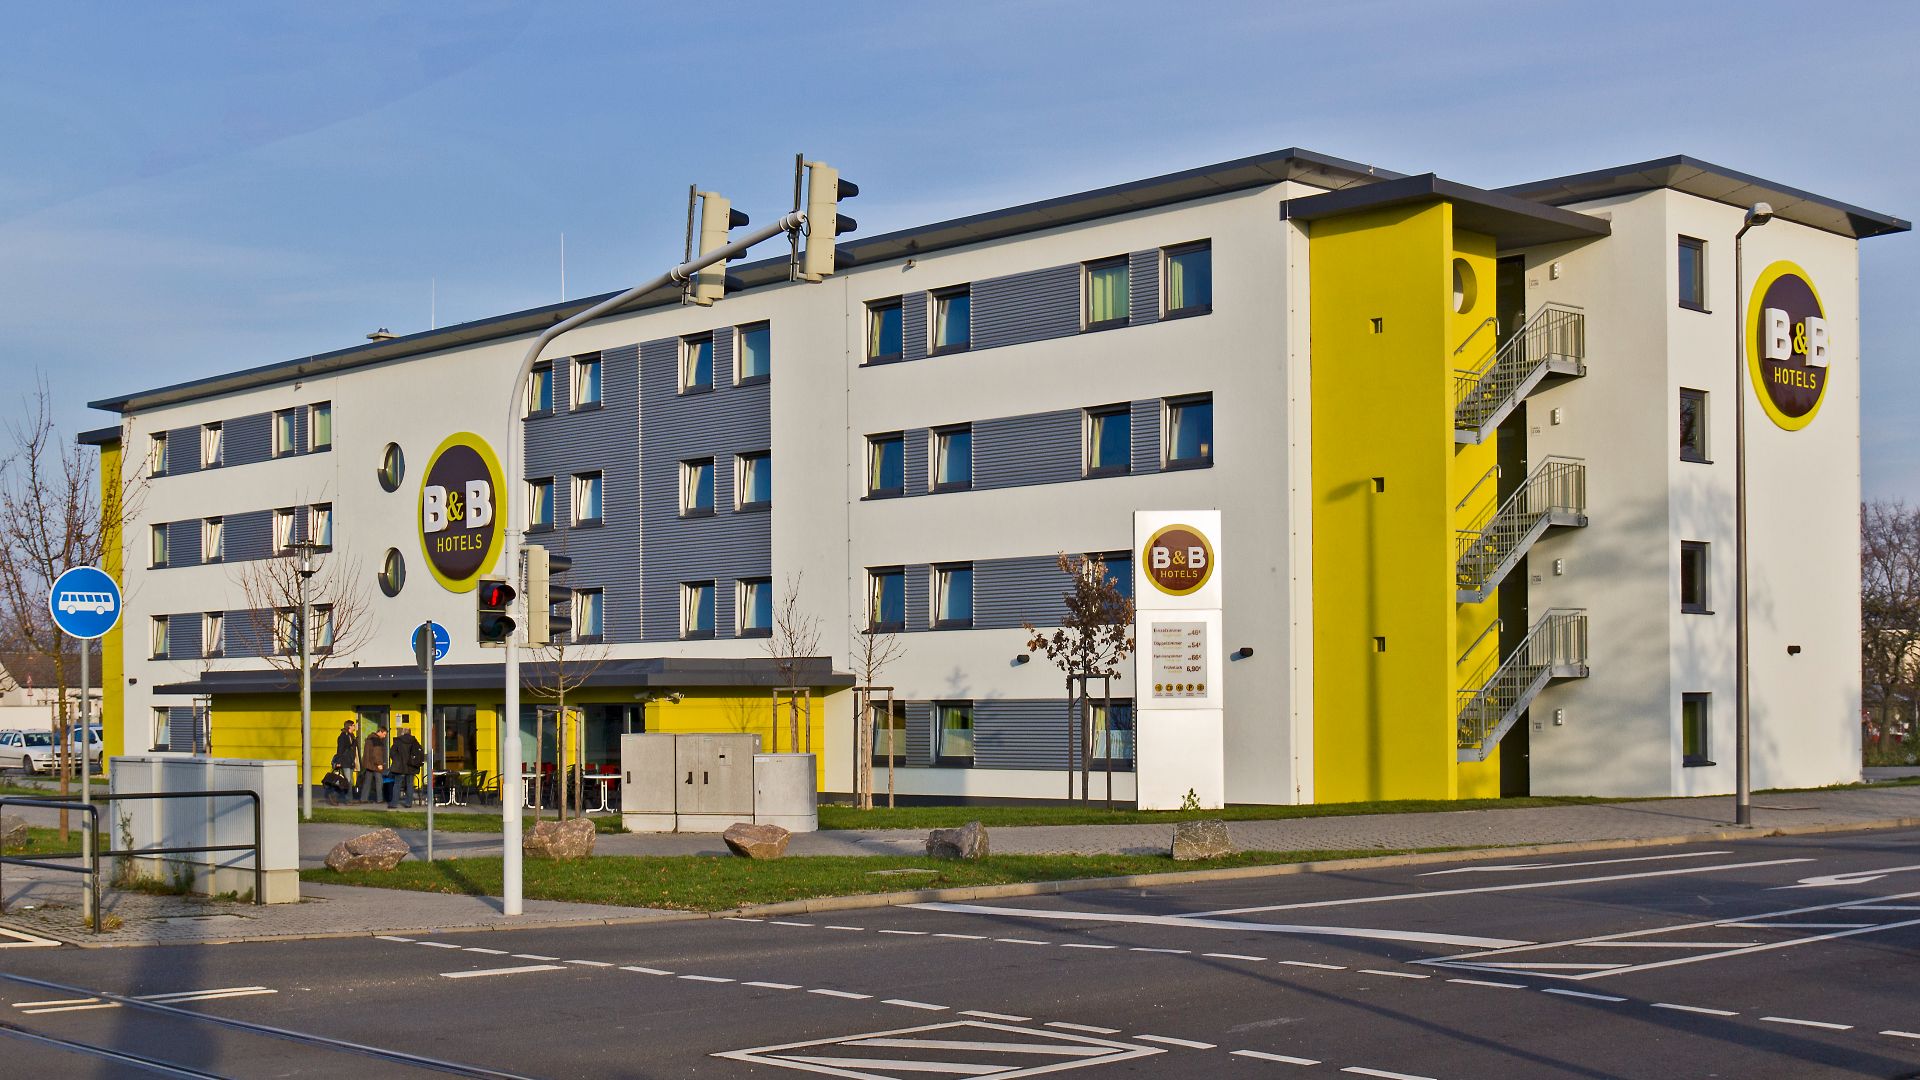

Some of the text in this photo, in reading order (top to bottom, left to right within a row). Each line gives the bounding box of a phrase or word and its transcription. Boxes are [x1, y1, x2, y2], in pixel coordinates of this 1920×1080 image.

[1765, 308, 1830, 368] B&B
[1774, 366, 1816, 390] HOTELS
[424, 480, 492, 533] B&B
[437, 533, 482, 553] HOTELS
[1152, 546, 1206, 569] B&B
[1160, 570, 1198, 578] HOTELS
